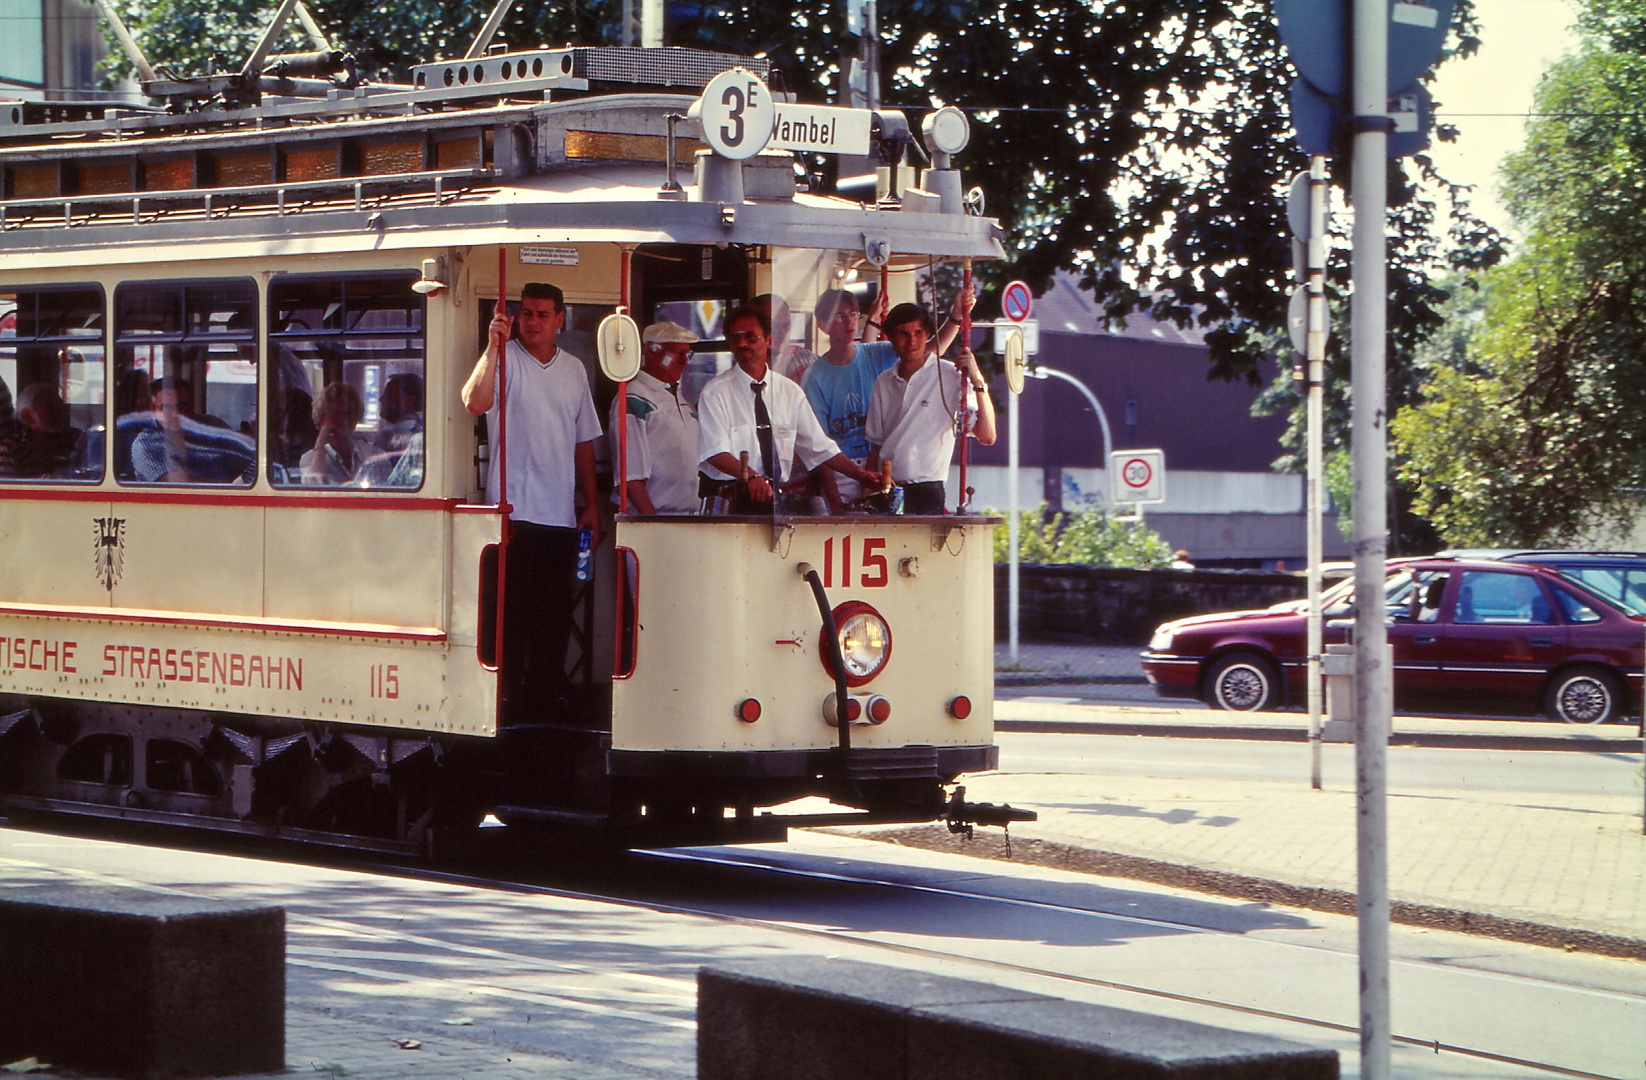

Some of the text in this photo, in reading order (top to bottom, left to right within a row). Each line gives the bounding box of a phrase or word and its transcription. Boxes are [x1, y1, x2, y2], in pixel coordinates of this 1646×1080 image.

[1129, 465, 1147, 480] 30
[824, 534, 888, 588] 115
[102, 644, 302, 691] STRASSENBAHN
[371, 664, 398, 699] 115
